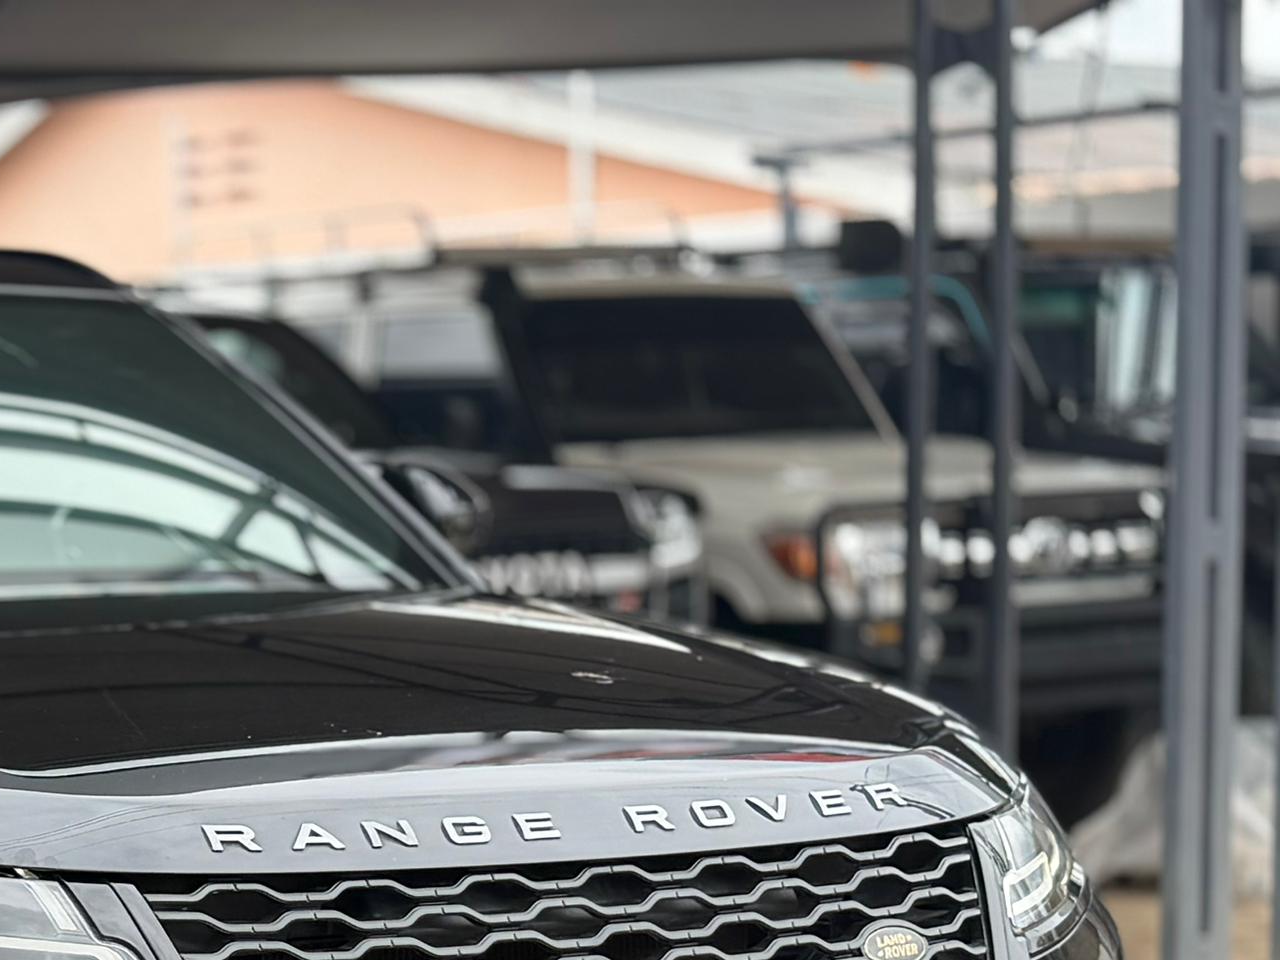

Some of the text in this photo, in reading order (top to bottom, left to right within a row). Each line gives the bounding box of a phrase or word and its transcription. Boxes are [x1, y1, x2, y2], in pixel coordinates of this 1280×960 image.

[201, 783, 907, 852] RANGE ROVER
[876, 933, 906, 949] LAND
[884, 943, 919, 959] ROVER
